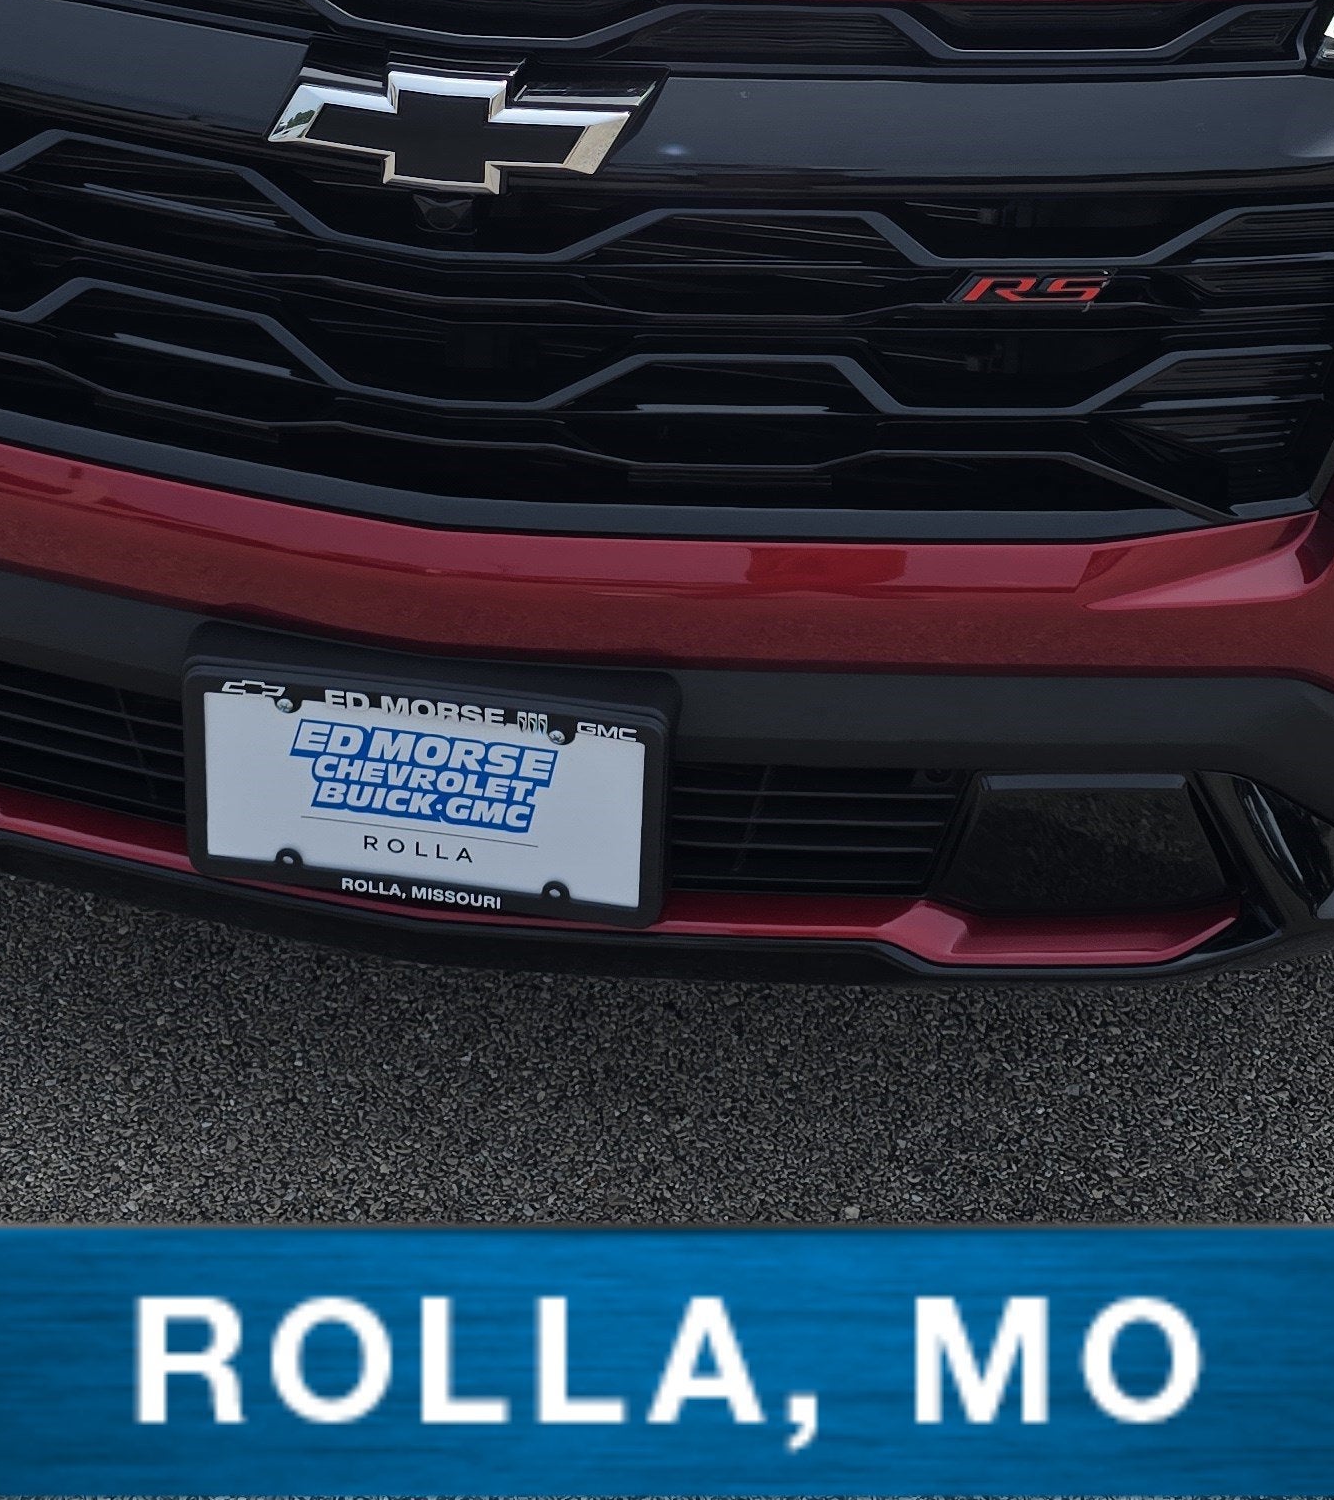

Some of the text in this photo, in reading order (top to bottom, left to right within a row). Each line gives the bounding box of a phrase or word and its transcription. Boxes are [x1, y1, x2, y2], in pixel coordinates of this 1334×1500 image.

[961, 276, 1109, 302] RS
[324, 689, 505, 727] ED MORSE
[576, 721, 638, 742] GMC
[294, 721, 555, 781] ED MORSE
[314, 754, 534, 802] CHEVROLET
[363, 835, 473, 864] ROLLA
[341, 877, 501, 910] ROLLA, MISSOURI
